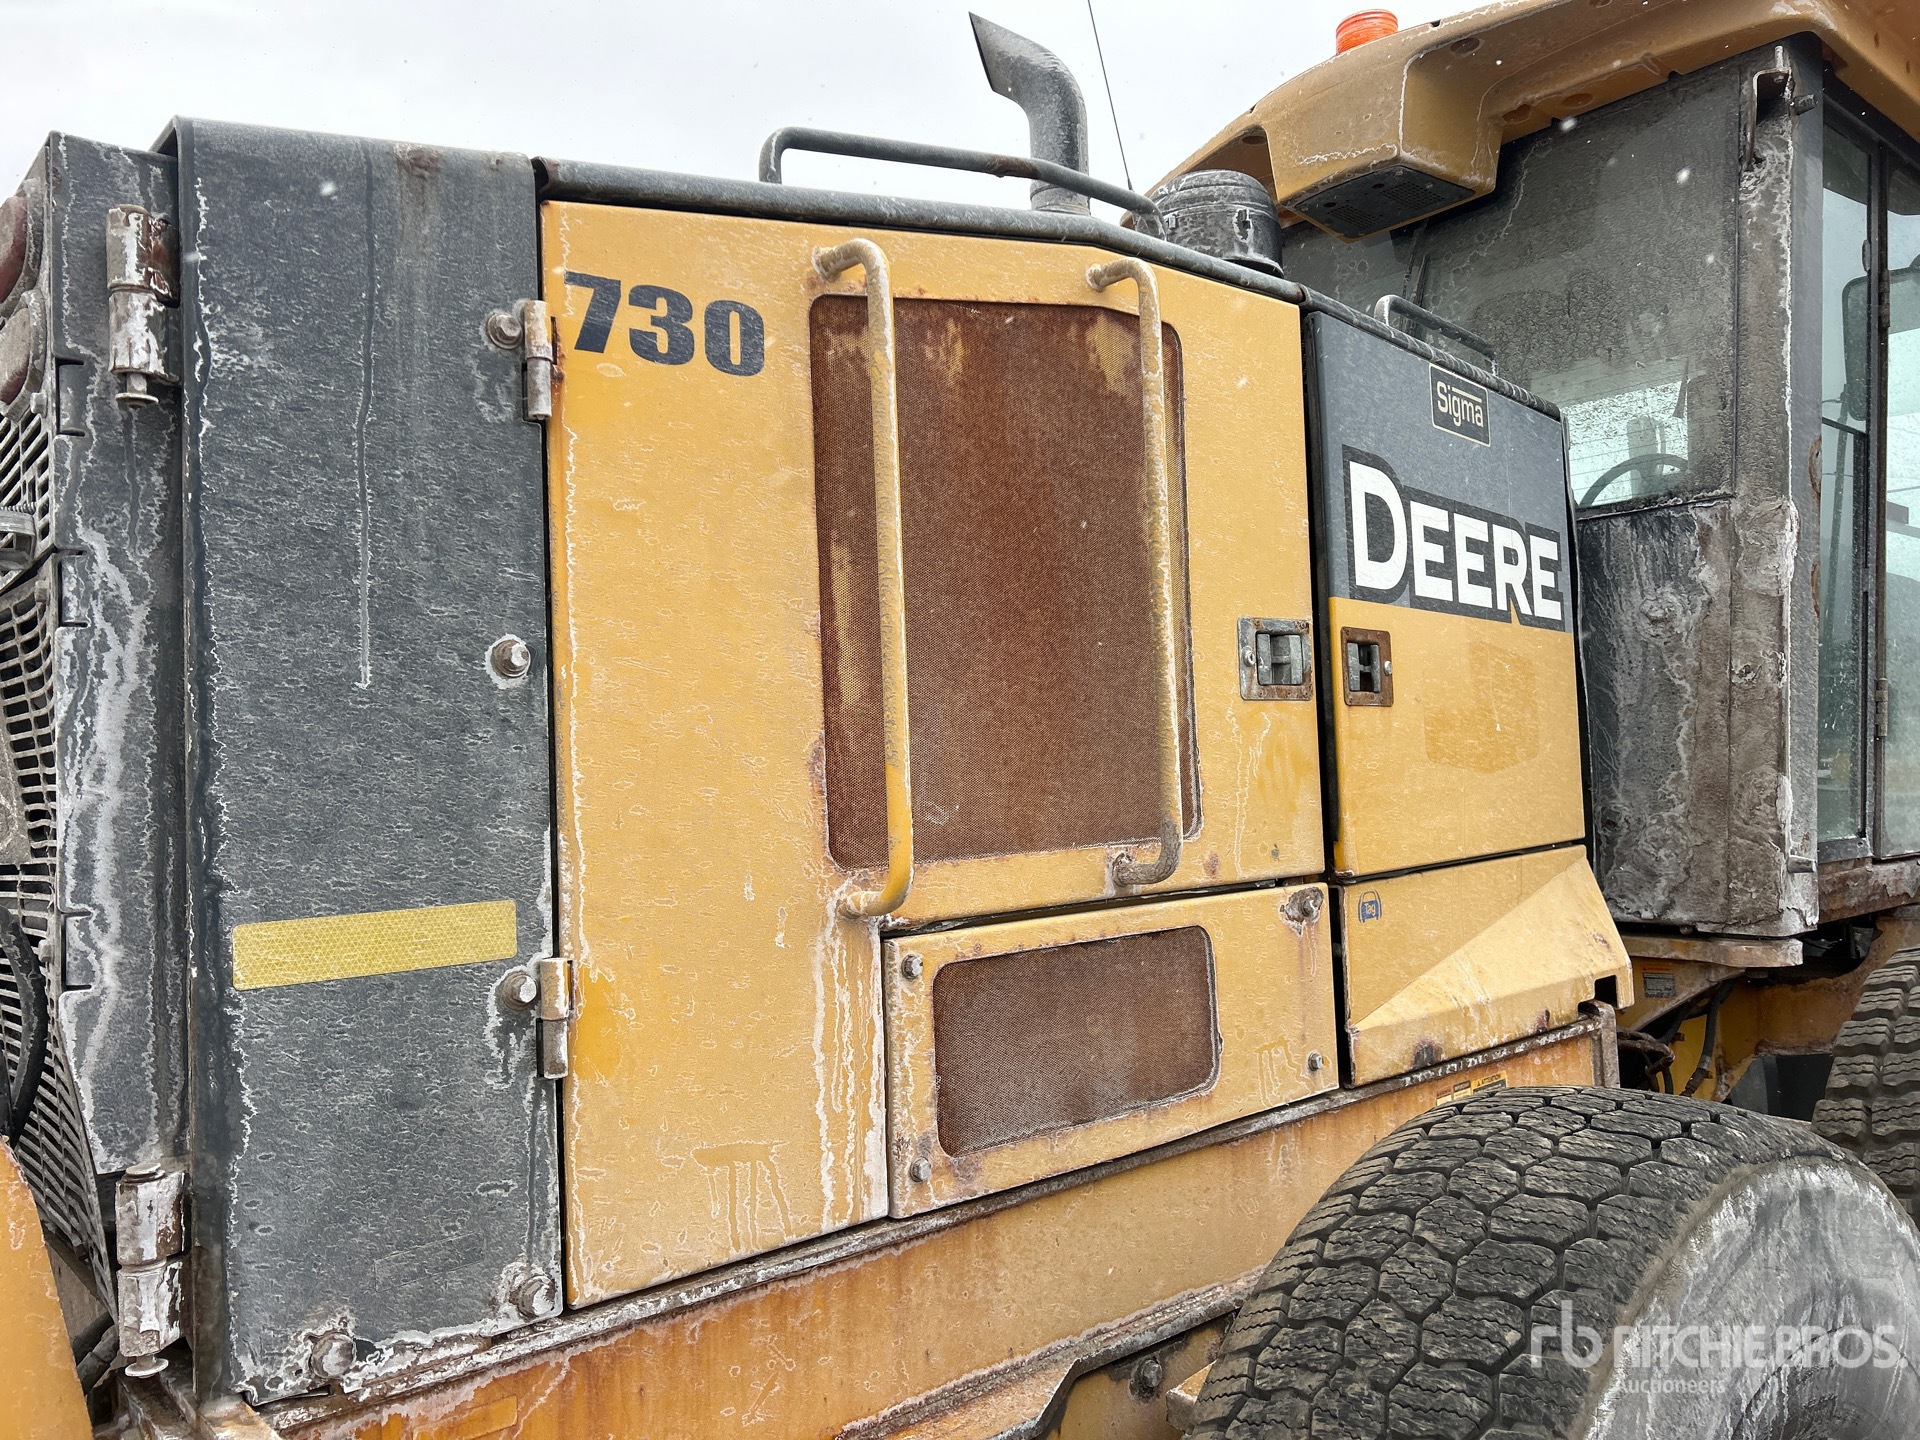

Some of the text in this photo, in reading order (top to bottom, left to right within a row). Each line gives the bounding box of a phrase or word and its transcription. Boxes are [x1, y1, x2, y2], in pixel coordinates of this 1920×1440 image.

[564, 270, 765, 377] 730
[1436, 380, 1484, 428] Sigma
[1348, 460, 1562, 621] DEERE
